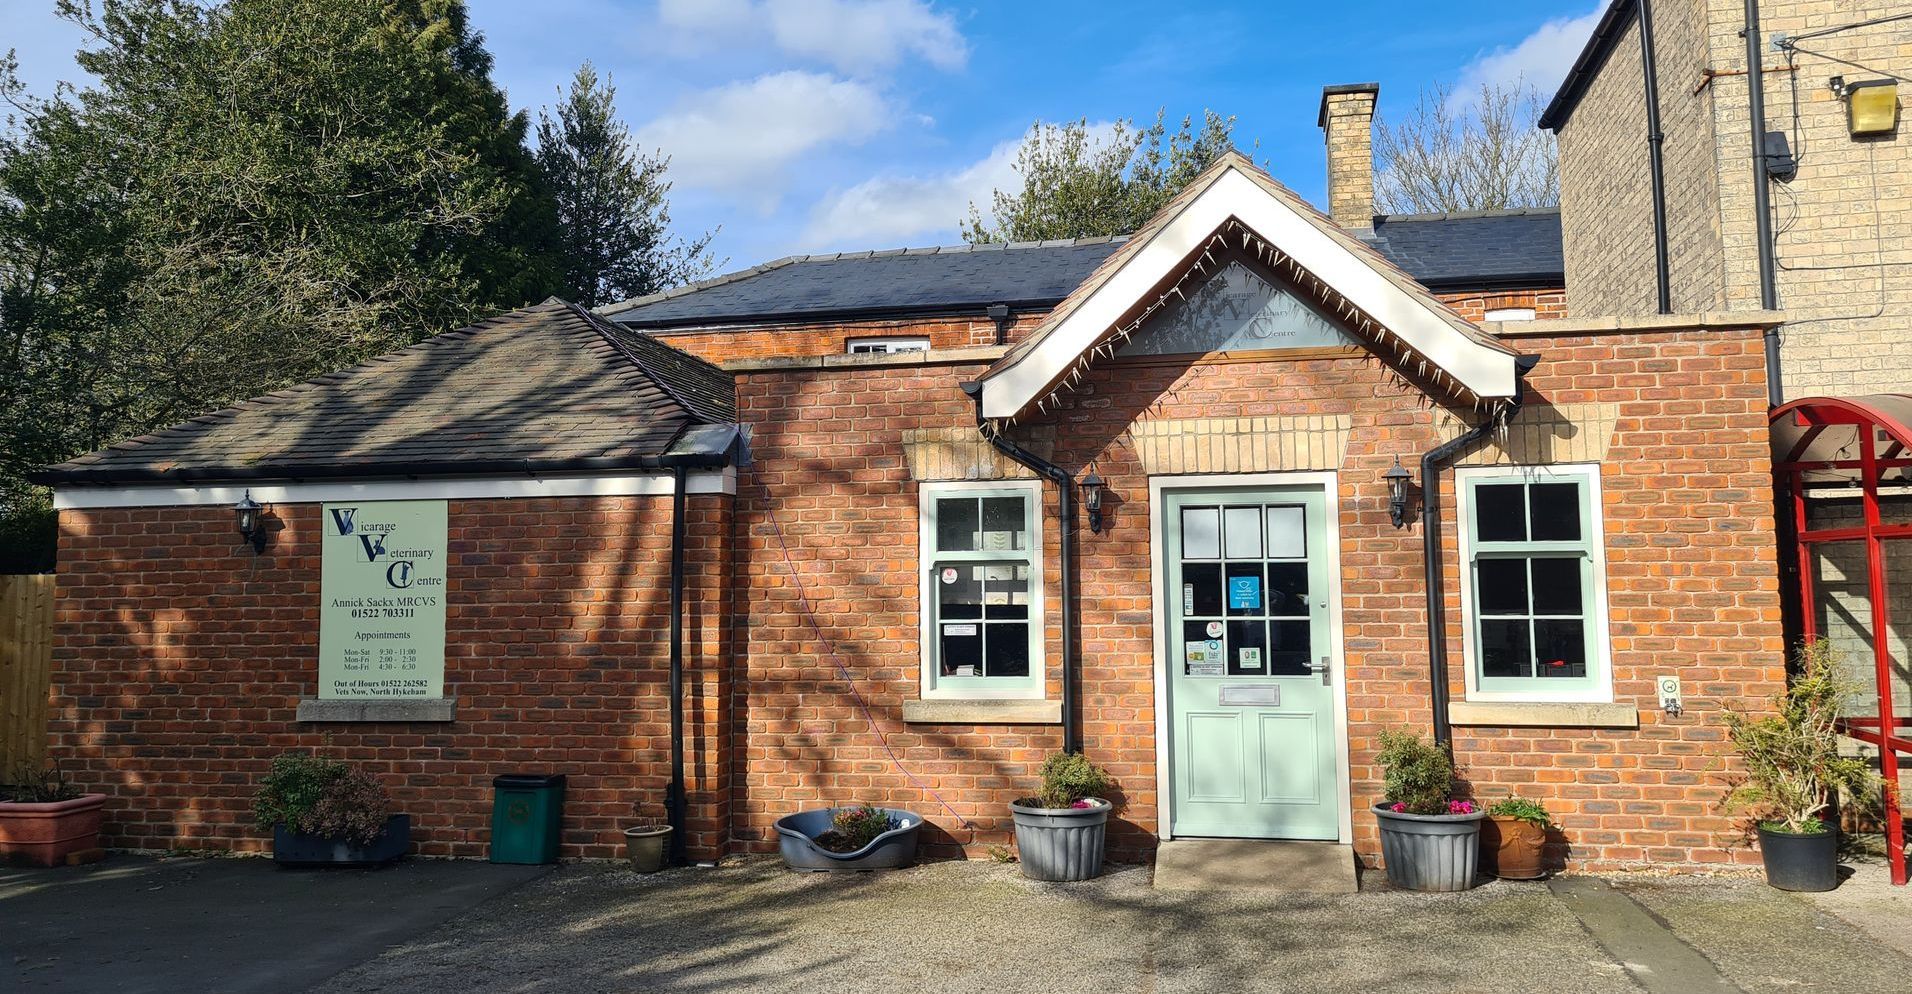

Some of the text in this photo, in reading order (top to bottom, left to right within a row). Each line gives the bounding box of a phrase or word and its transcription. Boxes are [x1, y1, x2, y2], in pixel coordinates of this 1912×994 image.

[331, 596, 436, 608] Annick Sackx MRCVS
[351, 608, 414, 618] 01522 703311
[354, 630, 411, 641] Appointments
[344, 648, 370, 656] Mon-Sat
[379, 648, 393, 656] 9:30
[334, 680, 348, 688] Out
[349, 680, 356, 688] of
[358, 680, 379, 688] Hours
[392, 688, 427, 697] Hykeham
